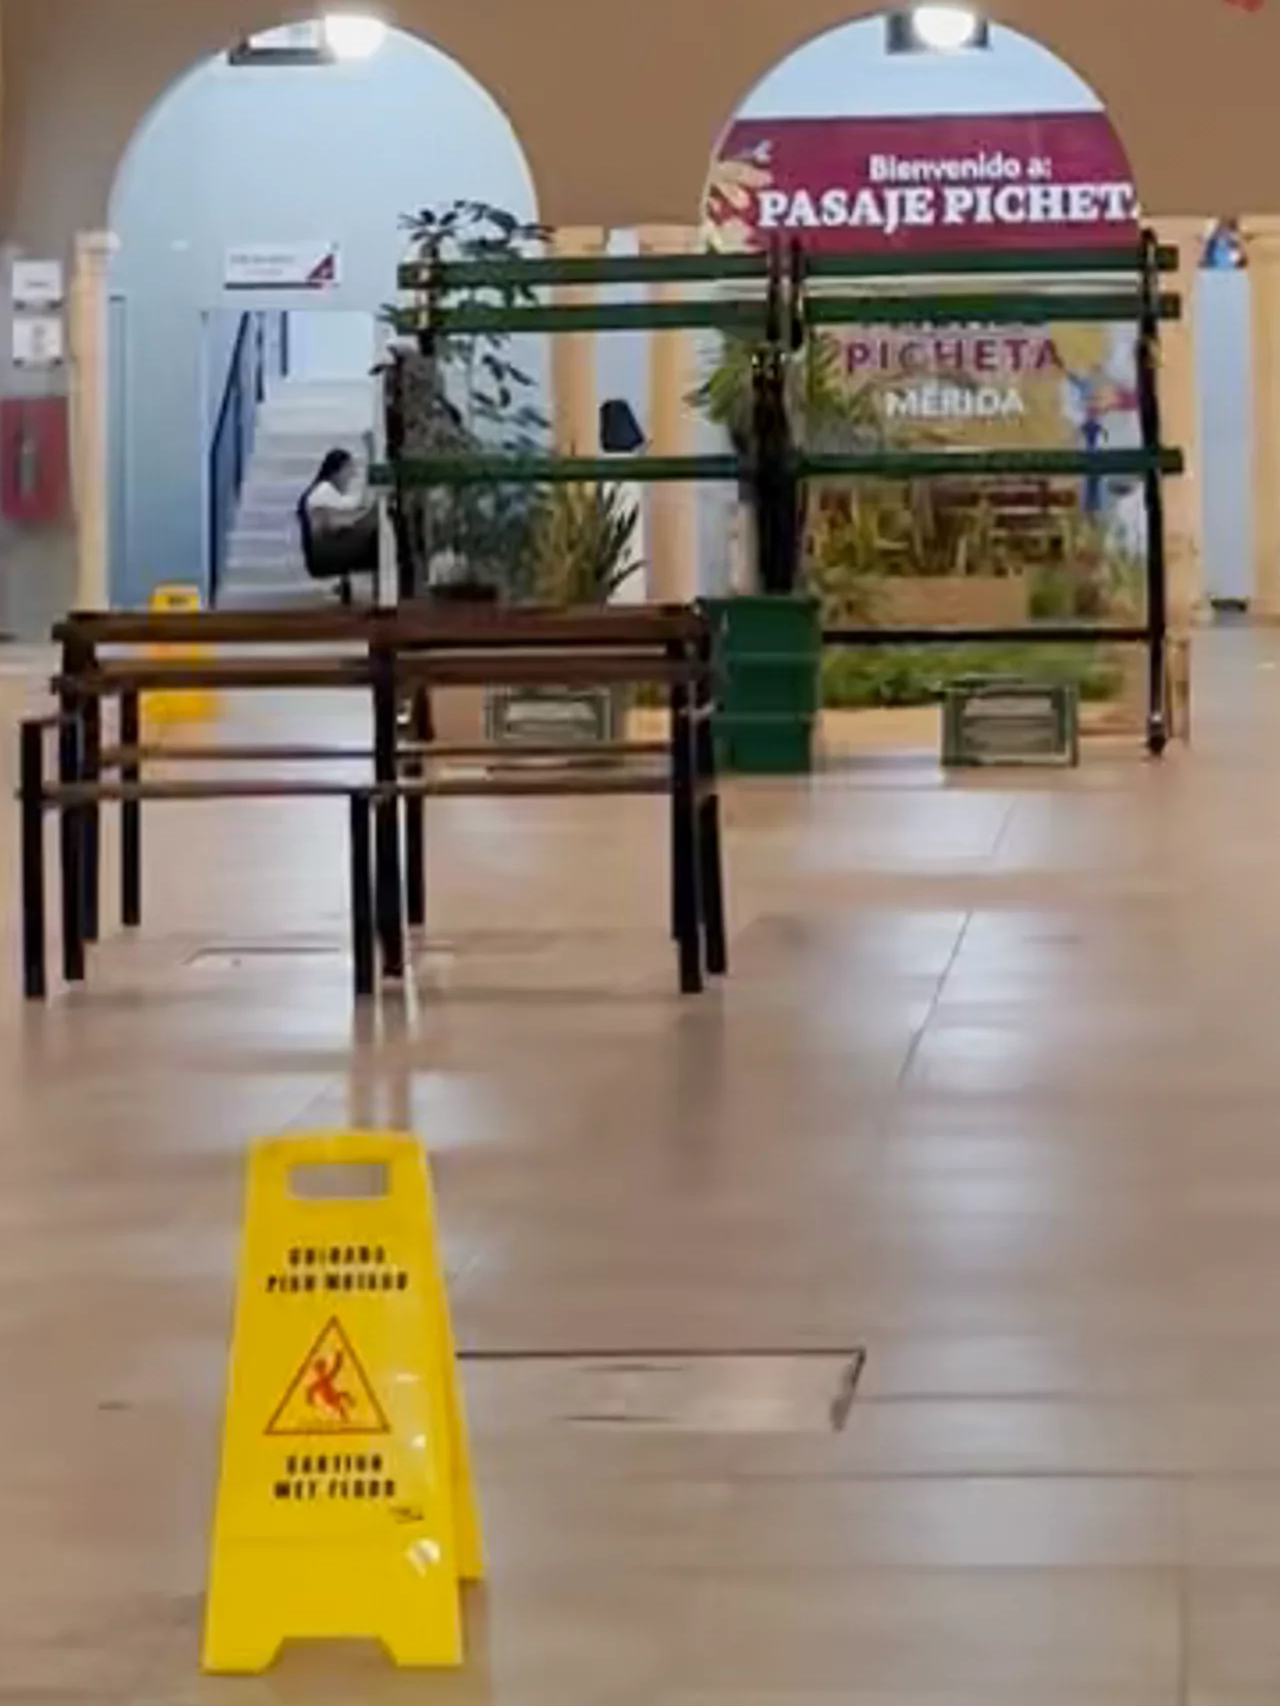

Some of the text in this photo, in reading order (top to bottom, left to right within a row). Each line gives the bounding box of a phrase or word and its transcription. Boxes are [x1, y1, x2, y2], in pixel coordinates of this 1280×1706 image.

[869, 151, 1052, 183] Bienvenido a:
[757, 182, 1140, 234] PASAJE PICHET
[846, 337, 1063, 373] PICHETA
[285, 1453, 383, 1474] CAUTION
[274, 1478, 396, 1500] WET FLOOR
